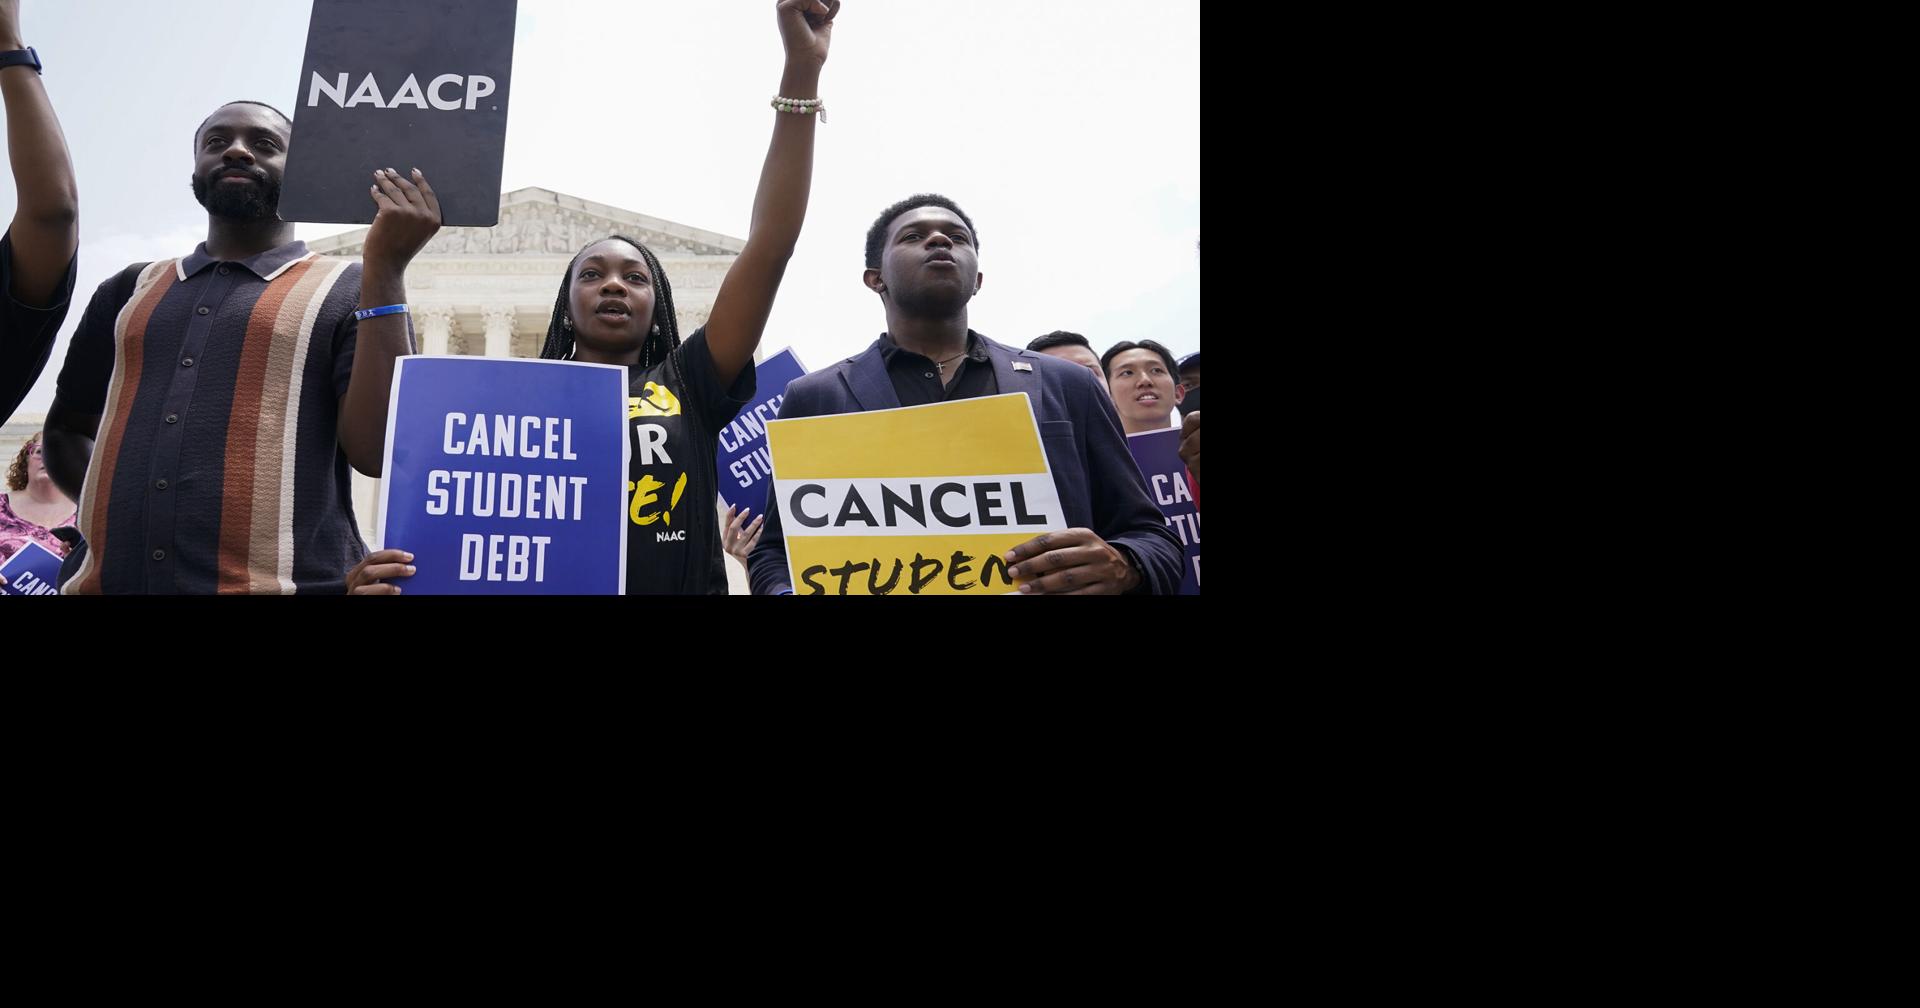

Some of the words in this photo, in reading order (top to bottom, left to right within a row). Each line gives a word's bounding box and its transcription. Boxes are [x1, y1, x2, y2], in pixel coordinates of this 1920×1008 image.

[307, 70, 496, 110] NAACP
[443, 412, 577, 461] CANCEL
[629, 423, 673, 465] R
[719, 394, 784, 453] CANCE
[426, 470, 588, 520] STUDENT
[628, 471, 688, 527] E!
[789, 481, 1048, 528] CANCEL
[1164, 512, 1200, 546] TU
[459, 533, 551, 582] DEBT
